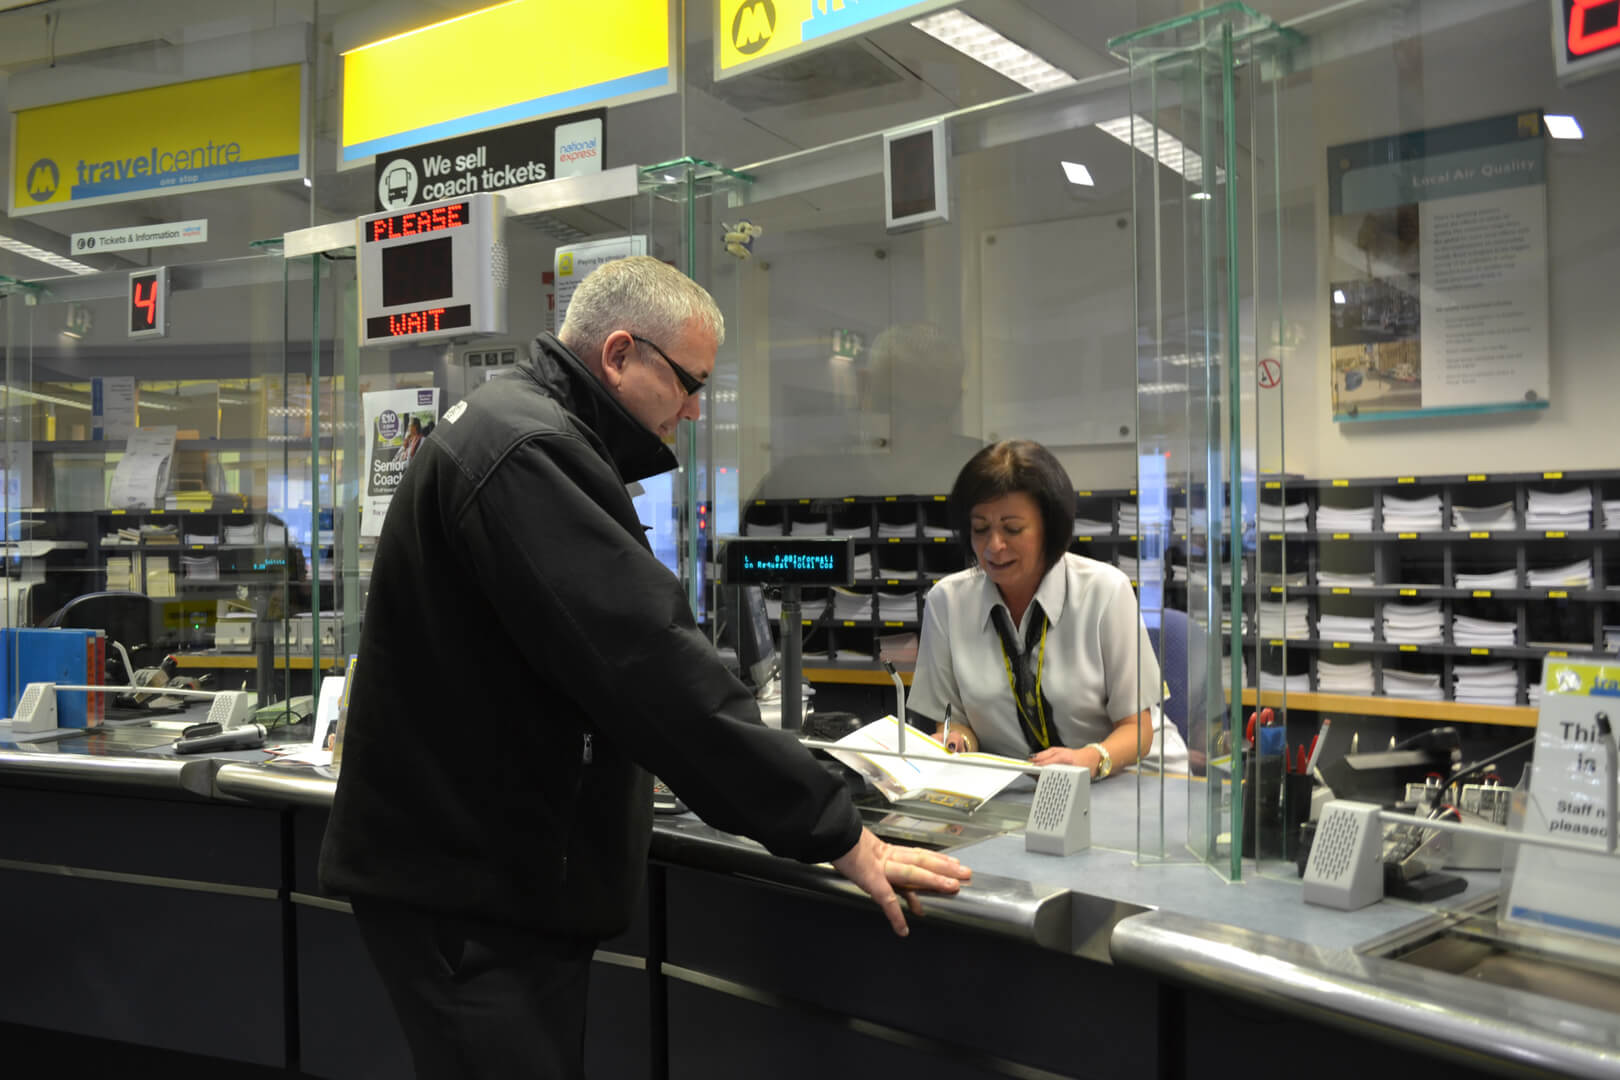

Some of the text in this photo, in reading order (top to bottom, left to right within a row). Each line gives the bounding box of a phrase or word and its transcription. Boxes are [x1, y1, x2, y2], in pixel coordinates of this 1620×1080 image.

[560, 138, 597, 154] national
[560, 148, 597, 164] express
[76, 140, 241, 186] travelcentre
[423, 146, 487, 178] We sell
[1411, 159, 1536, 188] Local Air Quality
[422, 162, 546, 200] coach tickets
[374, 204, 463, 242] PLEASE
[100, 235, 126, 246] Tickets
[135, 230, 180, 243] Information
[134, 280, 158, 324] 4
[390, 308, 446, 336] WAIT
[374, 459, 405, 472] Senior
[1593, 673, 1620, 688] tra
[1556, 799, 1593, 817] Staff
